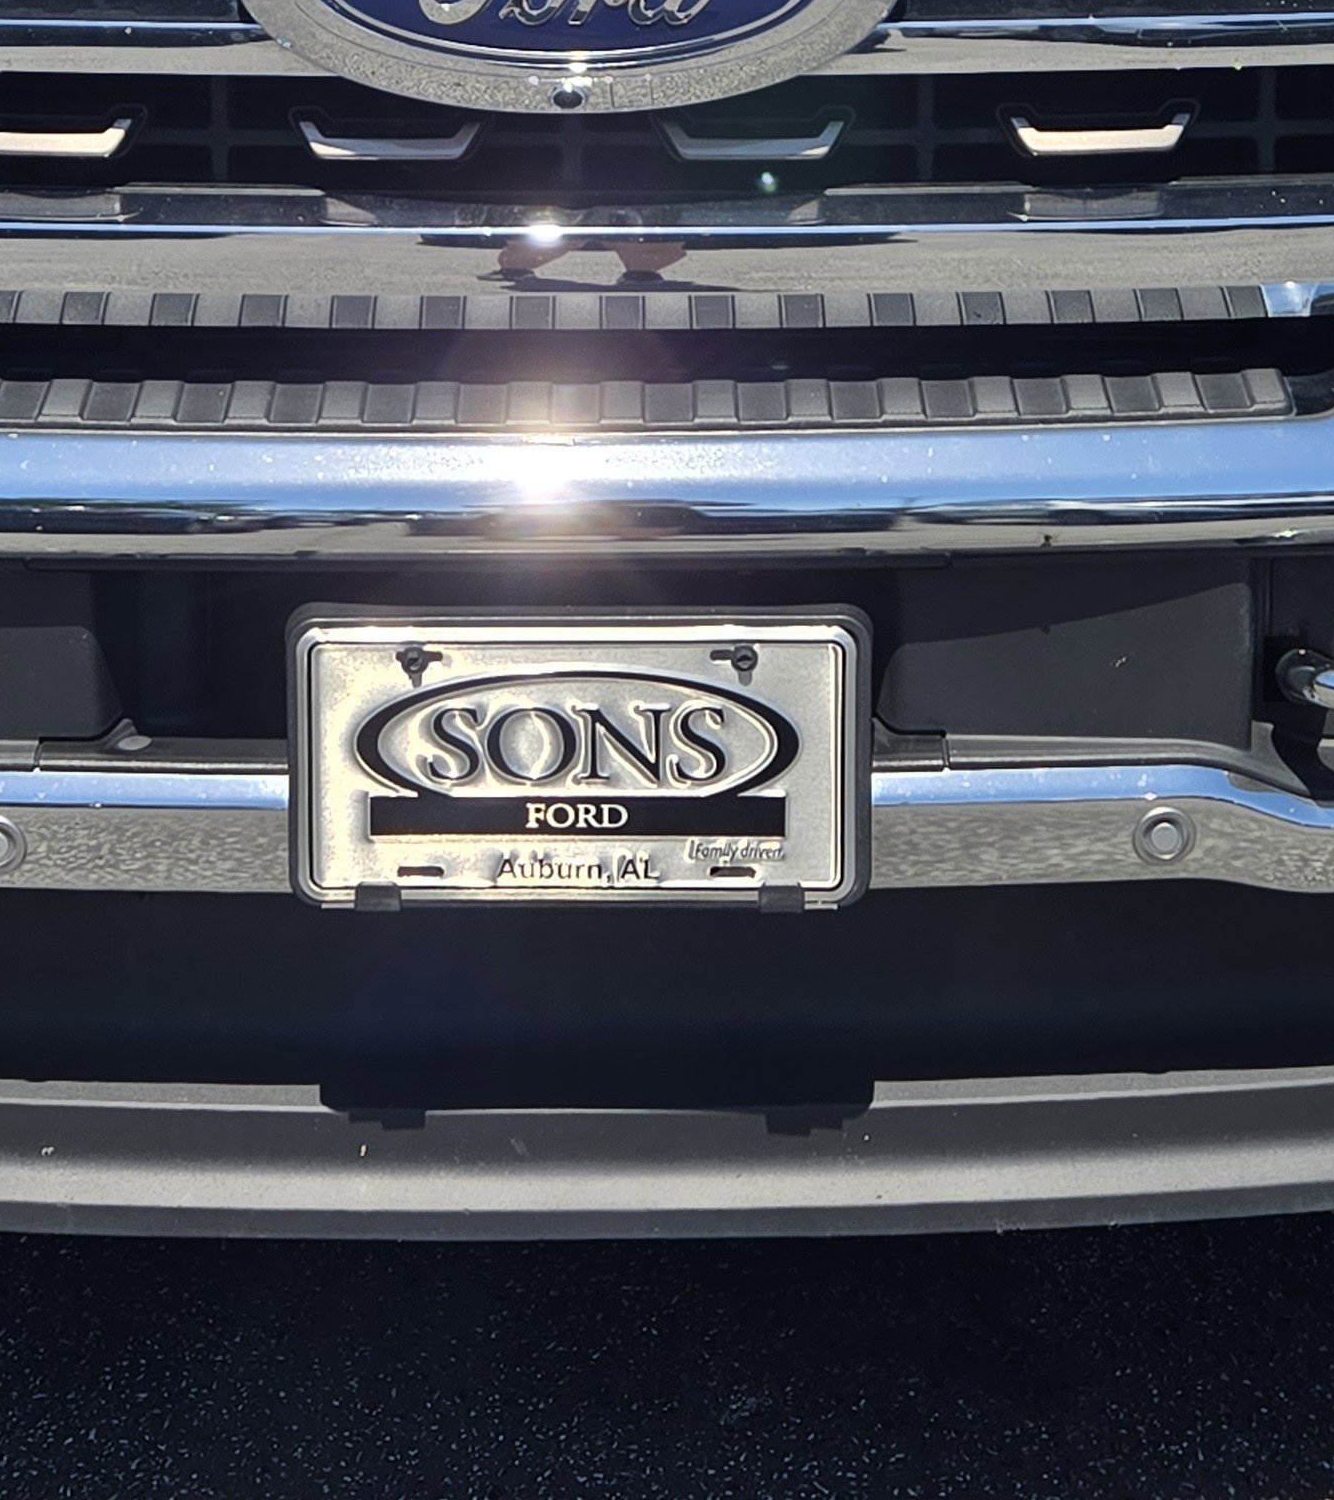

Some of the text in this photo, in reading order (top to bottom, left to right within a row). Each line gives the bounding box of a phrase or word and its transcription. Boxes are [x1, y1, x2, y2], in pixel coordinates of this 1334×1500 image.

[427, 705, 727, 781] SONS
[524, 803, 629, 829] FORD
[620, 858, 660, 880] AL
